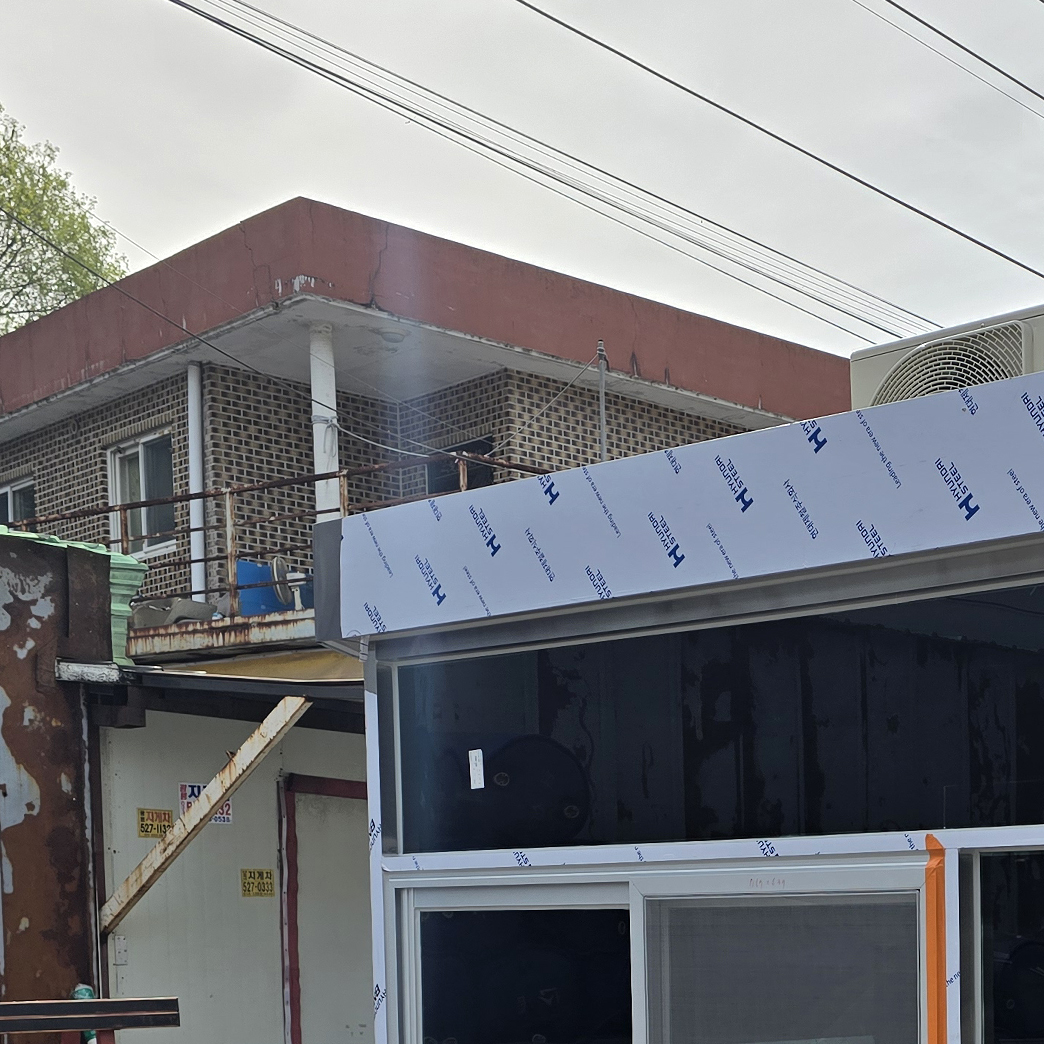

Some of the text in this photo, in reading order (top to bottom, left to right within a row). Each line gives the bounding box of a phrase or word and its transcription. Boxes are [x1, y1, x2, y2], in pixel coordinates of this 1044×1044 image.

[714, 454, 739, 496] HYUNDAI
[726, 458, 745, 489] STEEL
[934, 457, 963, 502] HYUNDAI
[948, 461, 969, 495] STEEL
[468, 503, 489, 542] HYUNDAI
[478, 507, 494, 536] STEEL
[647, 511, 671, 551] HYUNDAI
[659, 514, 677, 545] STEEL
[414, 554, 435, 591] HYUNDAI
[424, 557, 439, 586] STEEL
